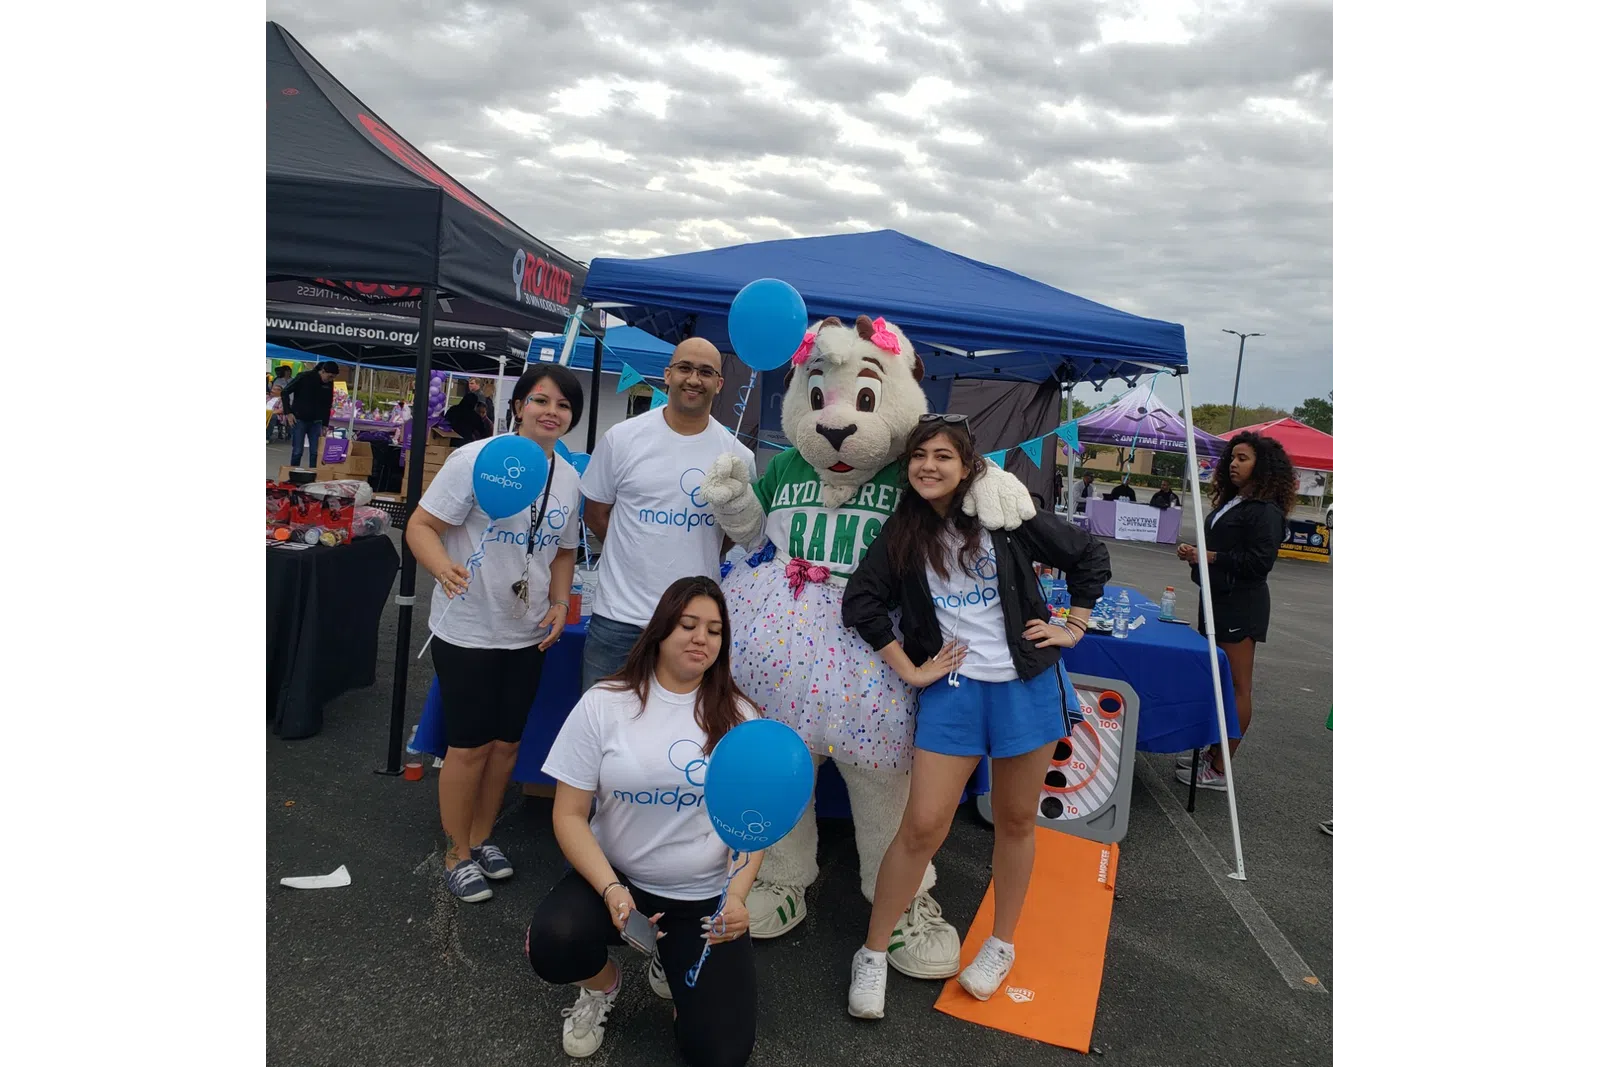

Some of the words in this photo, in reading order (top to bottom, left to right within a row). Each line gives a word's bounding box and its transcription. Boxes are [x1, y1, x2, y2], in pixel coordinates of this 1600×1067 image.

[1120, 435, 1158, 444] ANYTIME
[1160, 439, 1188, 448] FITNES
[480, 471, 523, 490] maidpro
[788, 512, 882, 566] RAMS
[1099, 720, 1118, 729] 100
[1072, 761, 1085, 770] 30
[613, 786, 704, 812] maidpr
[1066, 805, 1078, 815] 10
[713, 815, 769, 842] maidpro
